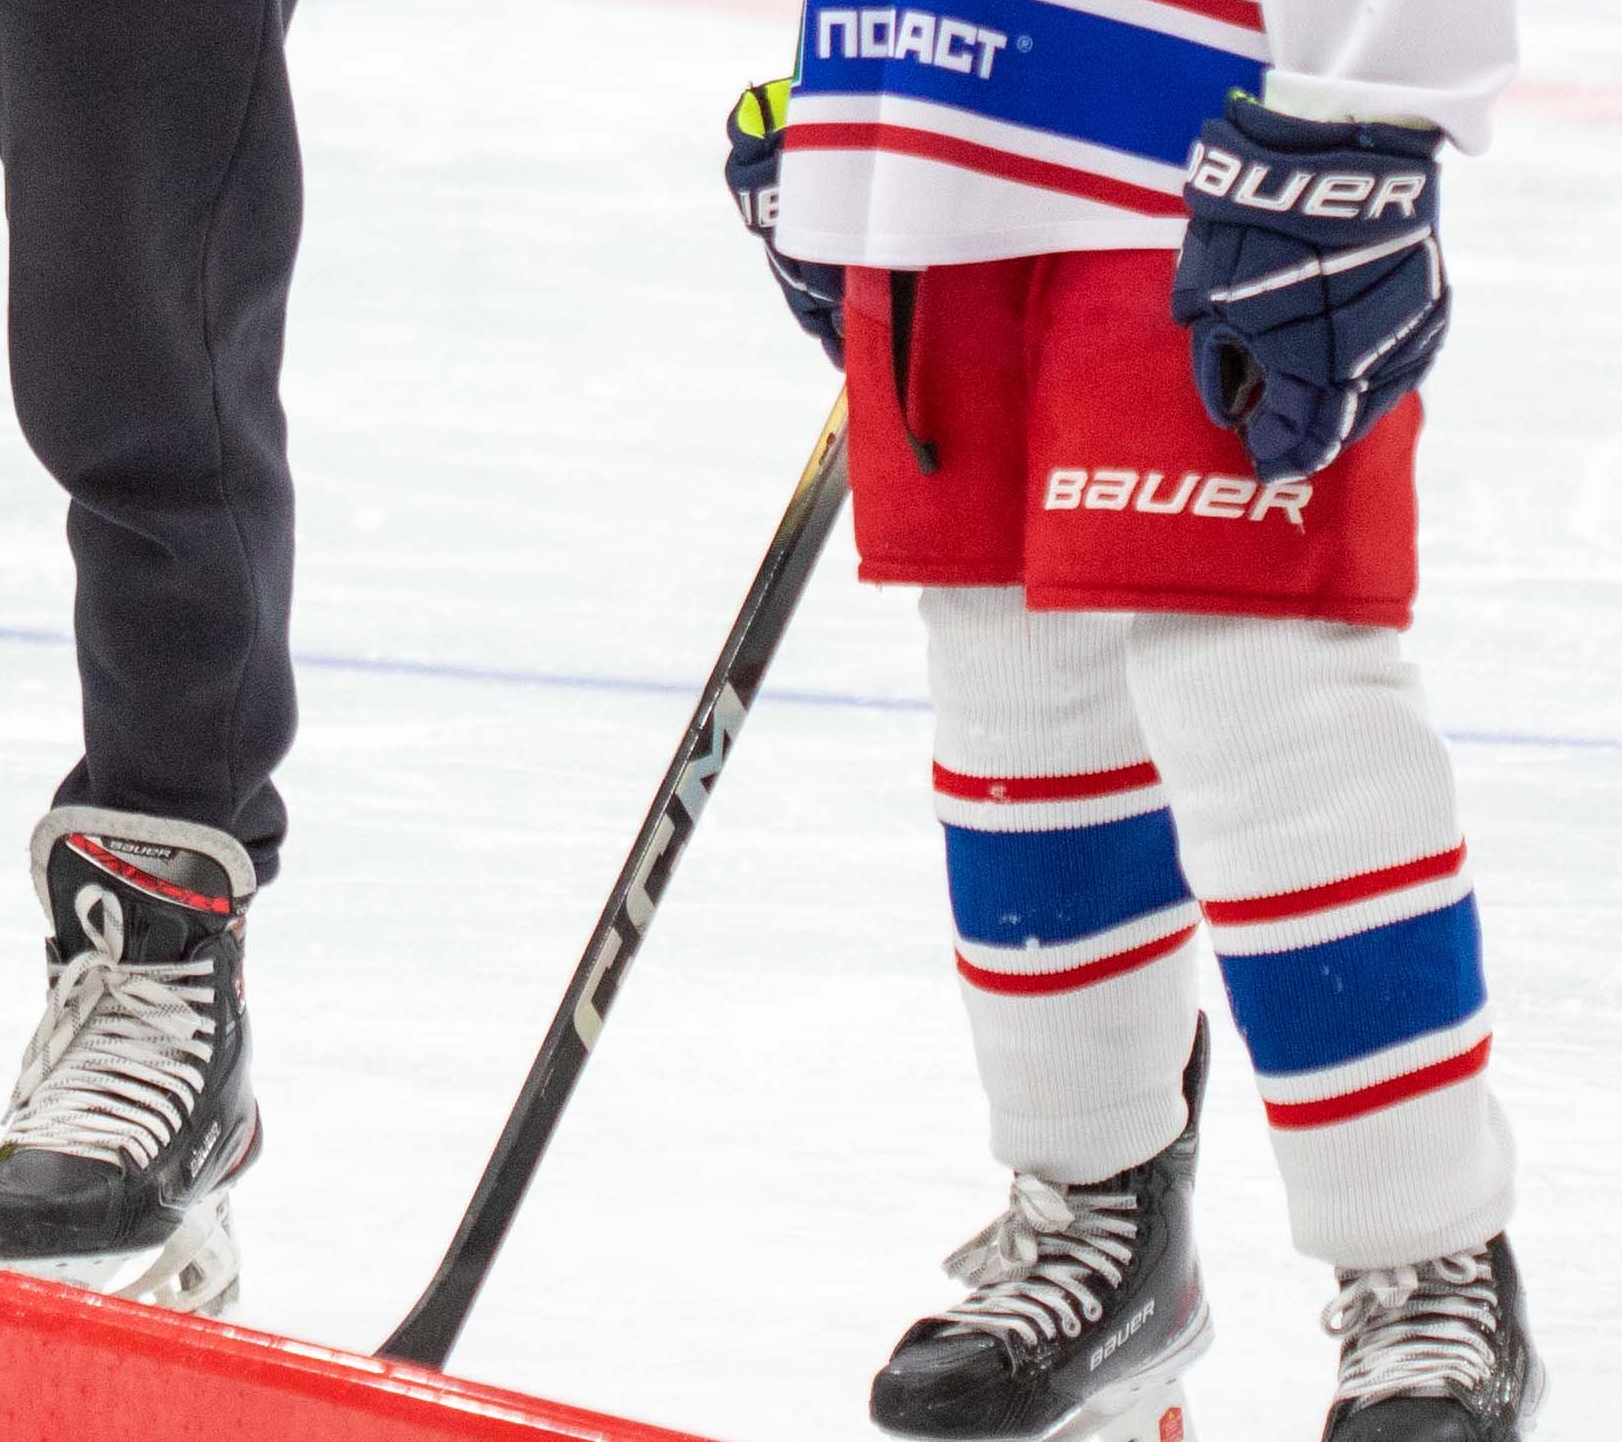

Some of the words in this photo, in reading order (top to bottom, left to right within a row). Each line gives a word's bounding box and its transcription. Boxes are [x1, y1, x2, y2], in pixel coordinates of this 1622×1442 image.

[1044, 467, 1315, 534] BAUER
[108, 840, 172, 859] BAUER
[1089, 1301, 1155, 1372] BAUER
